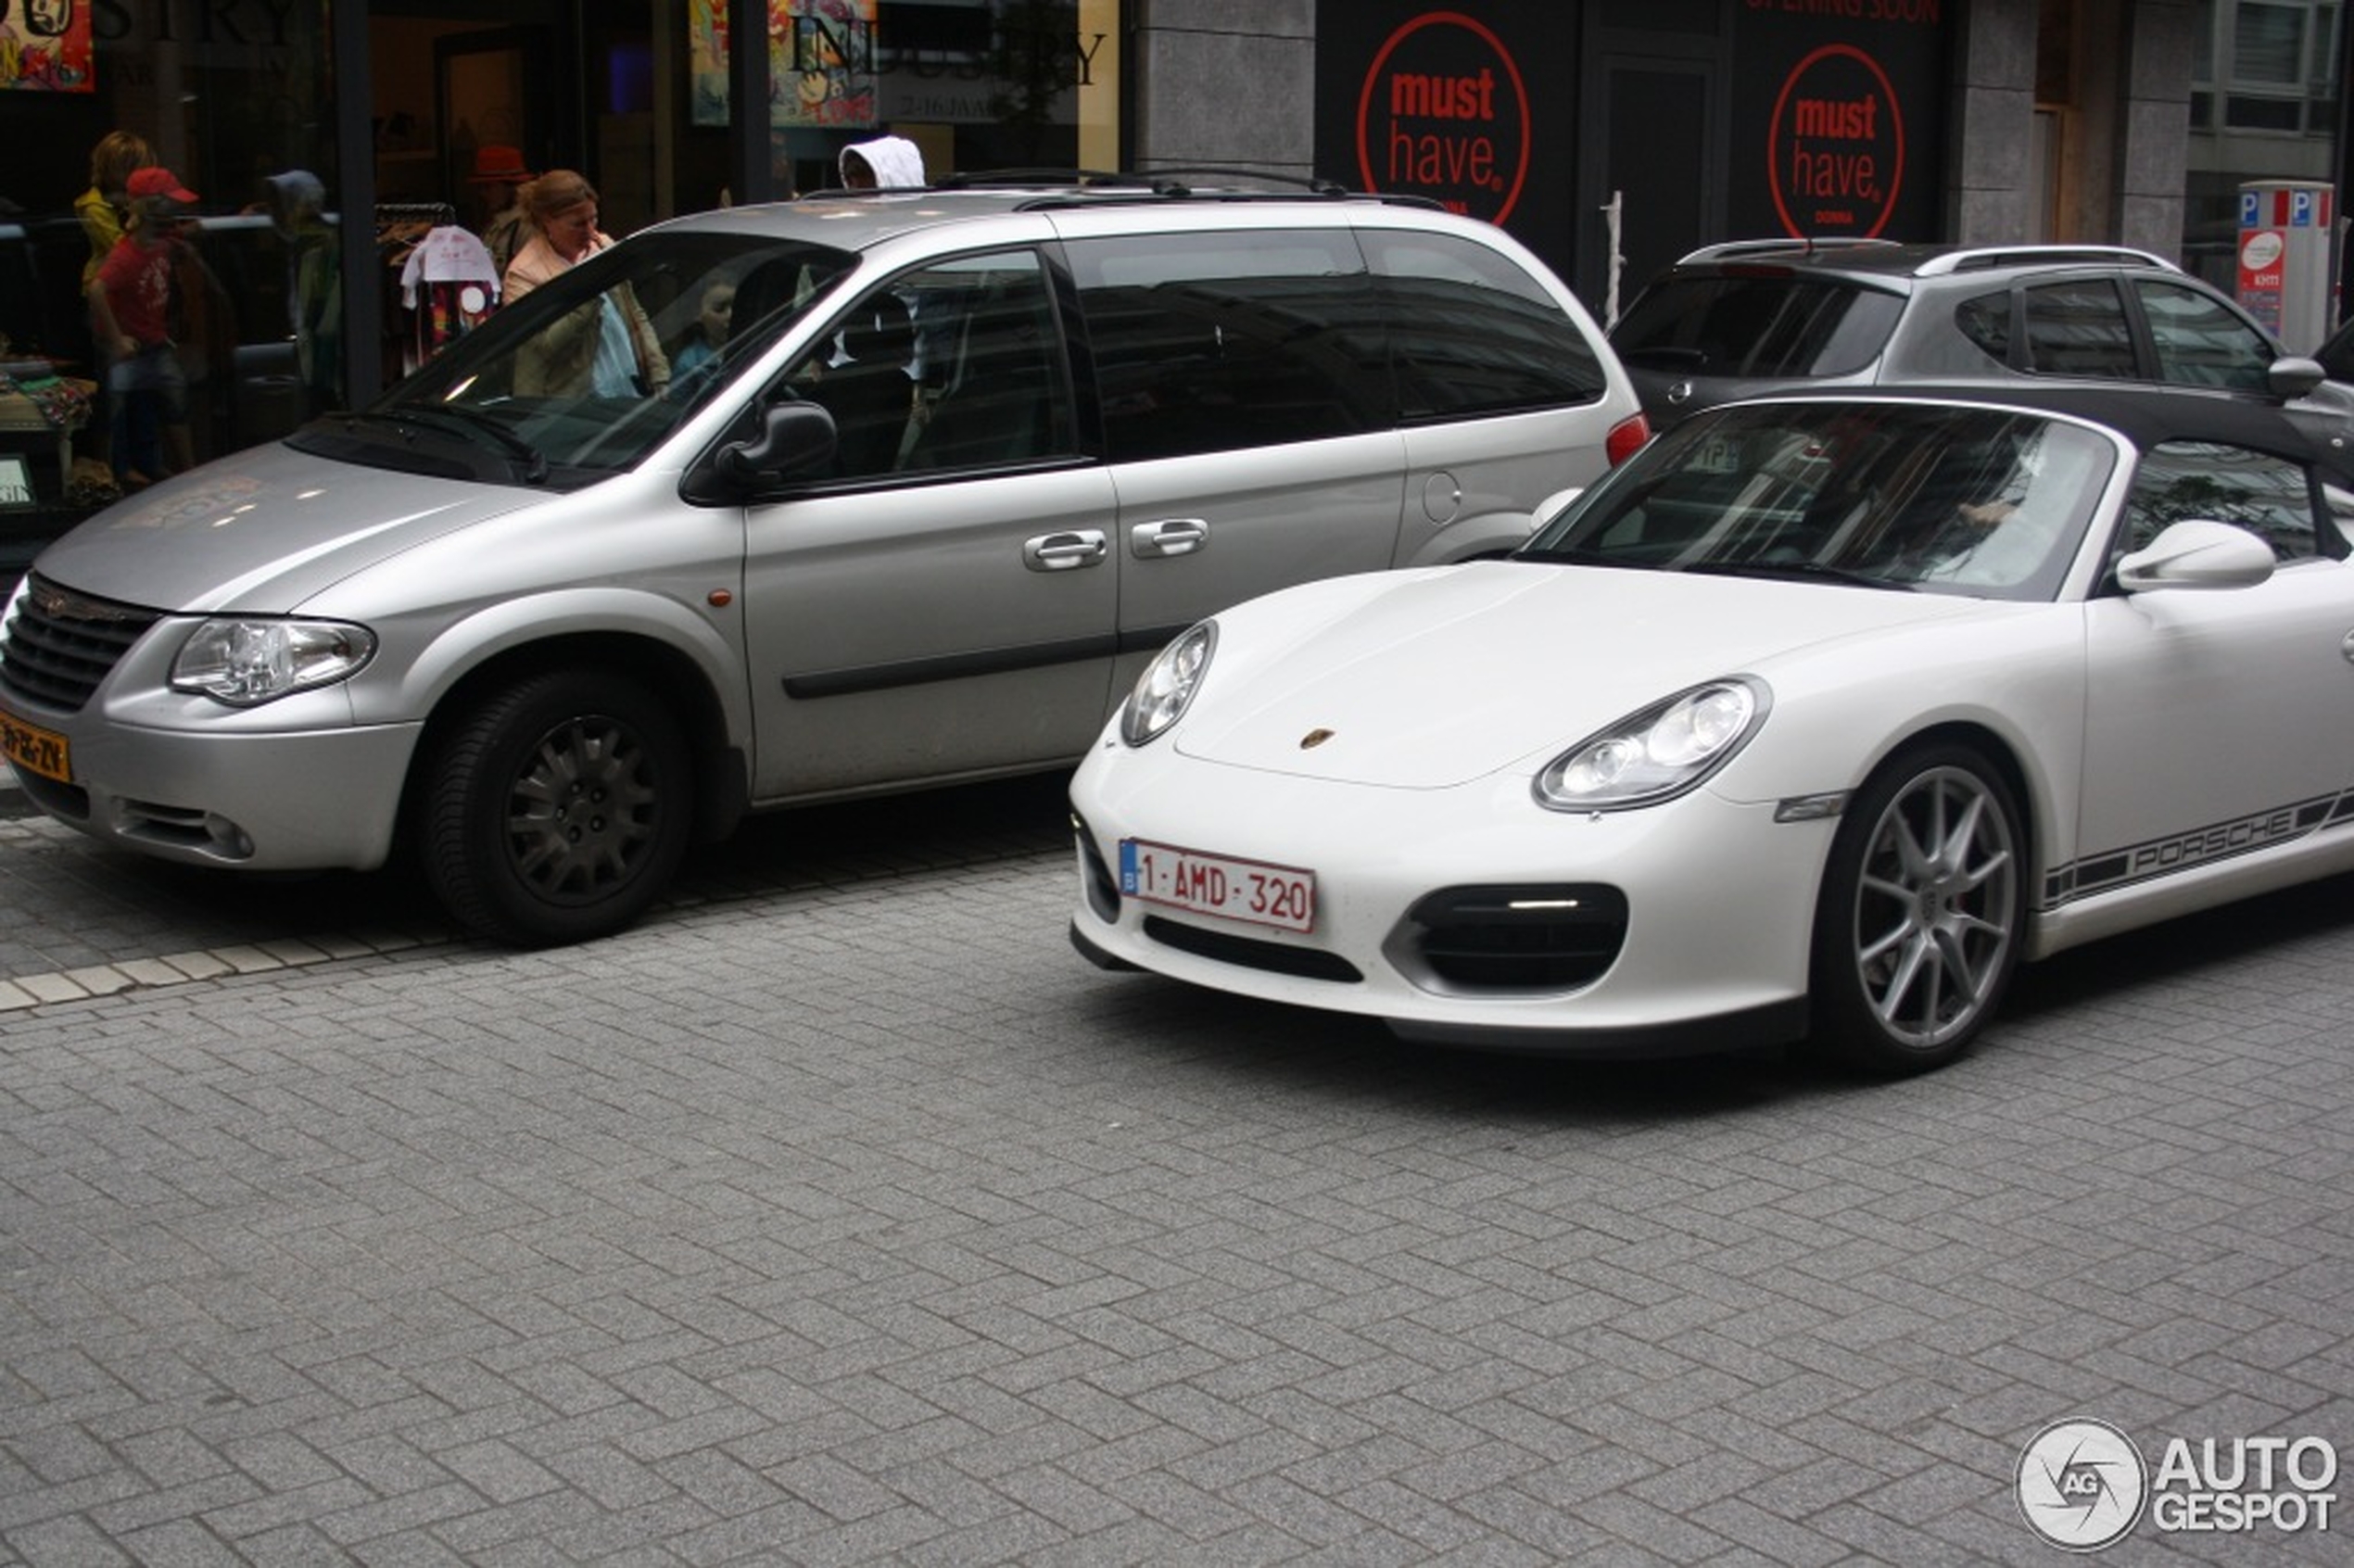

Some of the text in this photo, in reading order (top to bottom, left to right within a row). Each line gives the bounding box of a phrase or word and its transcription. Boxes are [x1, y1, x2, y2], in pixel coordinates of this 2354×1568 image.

[1391, 68, 1495, 121] must
[1795, 94, 1877, 140] must
[1815, 209, 1854, 224] DONNA
[2134, 812, 2294, 871] PORSCHE
